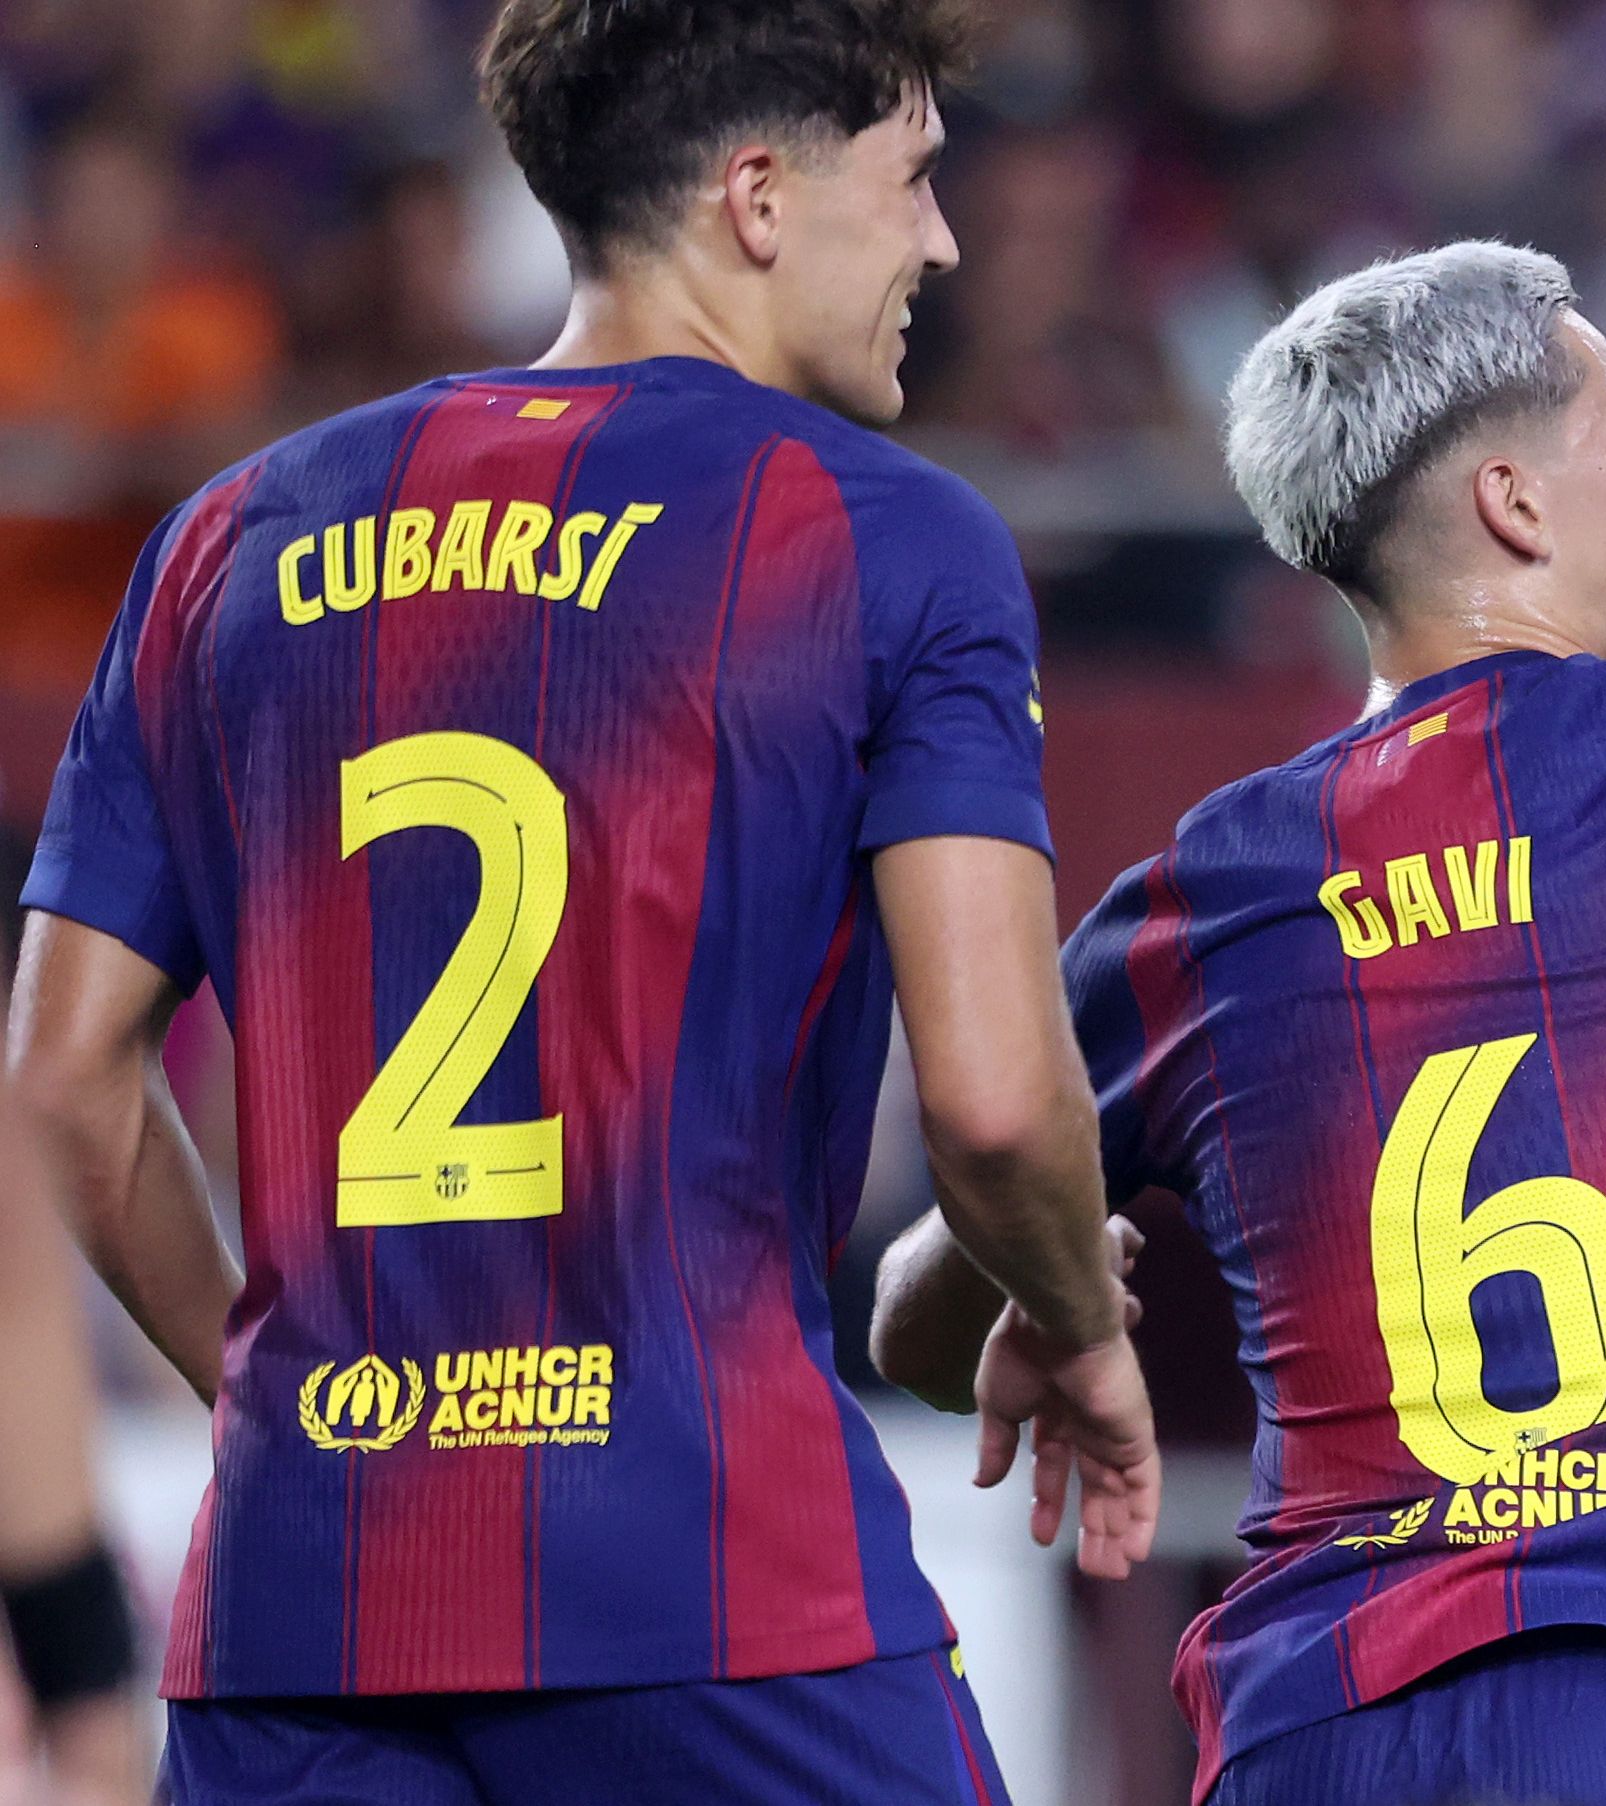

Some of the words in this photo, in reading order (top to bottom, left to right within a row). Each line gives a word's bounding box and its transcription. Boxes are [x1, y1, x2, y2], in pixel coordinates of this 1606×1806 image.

[278, 500, 664, 626] CUBARSÍ
[1318, 836, 1534, 959] GAVI
[336, 731, 568, 1228] 2
[435, 1344, 614, 1394] UNHCR
[428, 1385, 611, 1434] ACNUR
[429, 1433, 457, 1450] The
[459, 1431, 483, 1449] UN
[485, 1428, 548, 1448] Refugee
[550, 1427, 611, 1447] Agency
[1445, 1529, 1477, 1544] The
[1479, 1529, 1504, 1544] UN
